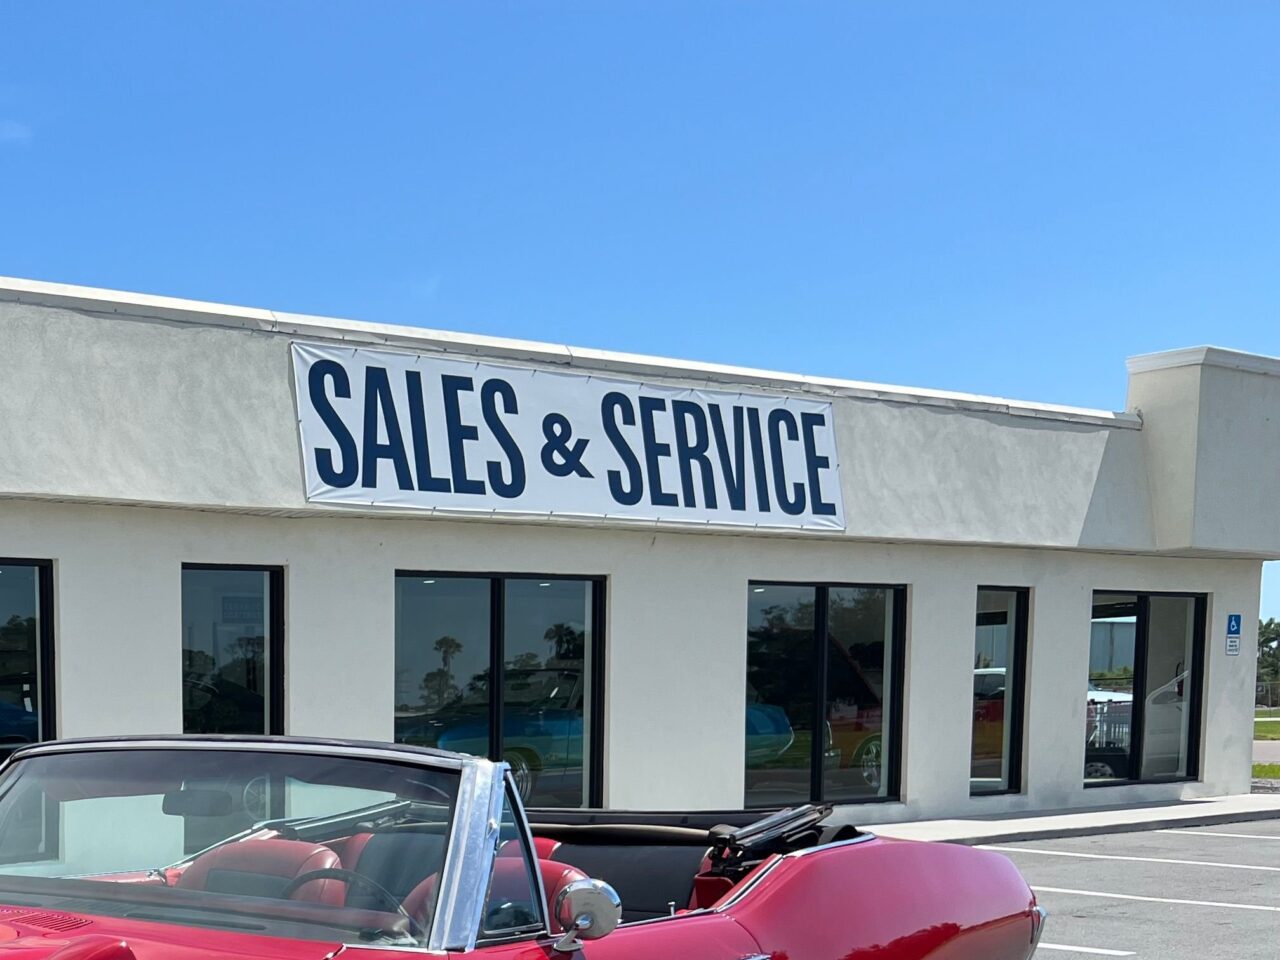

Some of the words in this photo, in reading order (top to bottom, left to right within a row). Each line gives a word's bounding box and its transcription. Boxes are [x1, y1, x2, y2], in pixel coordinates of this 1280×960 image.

[308, 359, 527, 500] SALES
[540, 412, 595, 479] &
[601, 391, 837, 516] SERVICE
